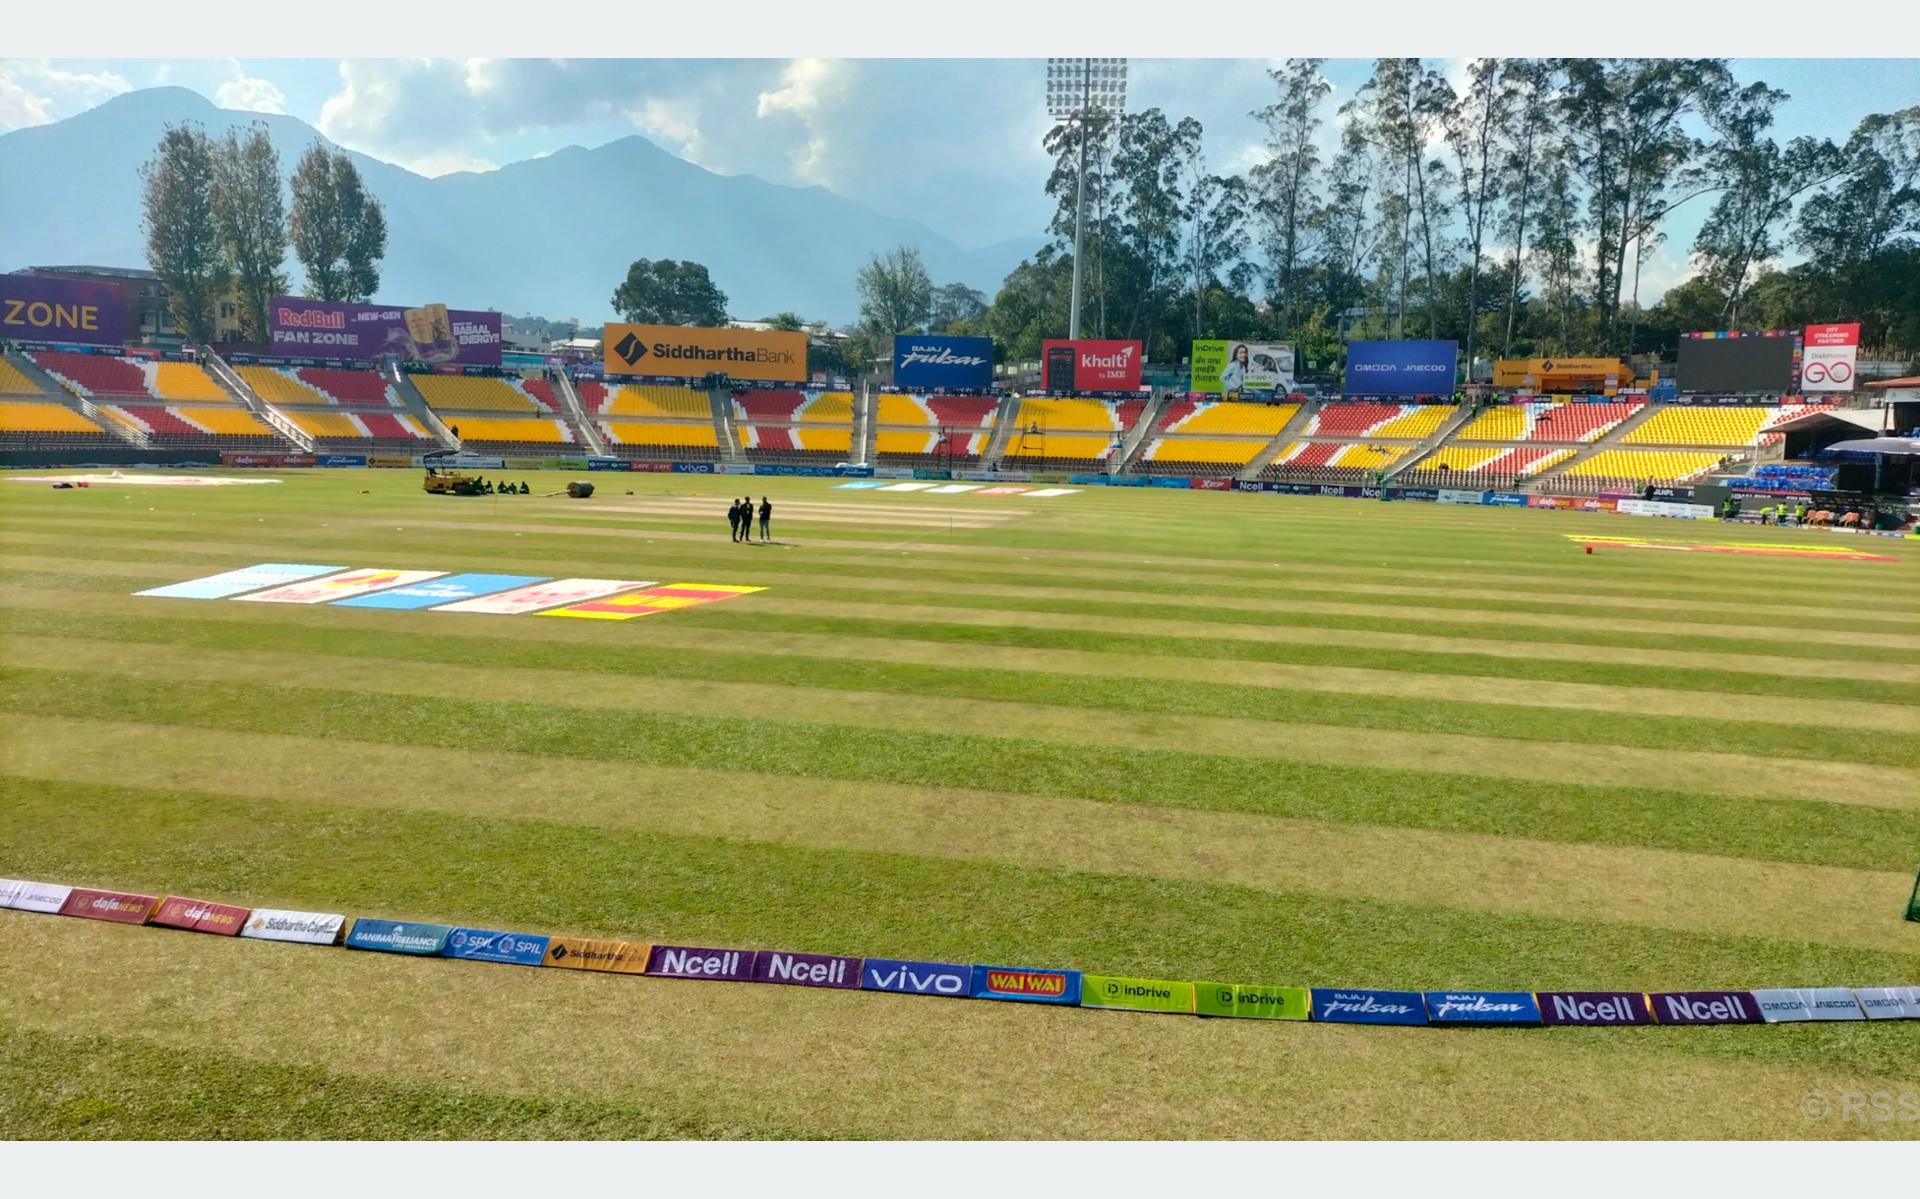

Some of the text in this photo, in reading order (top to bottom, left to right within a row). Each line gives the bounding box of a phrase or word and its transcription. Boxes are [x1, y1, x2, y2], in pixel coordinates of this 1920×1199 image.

[4, 299, 98, 330] ZONE
[278, 308, 345, 328] Red Bull
[274, 330, 358, 345] FAN ZONE
[1195, 344, 1224, 352] inDrive
[900, 348, 987, 368] pulsar
[1082, 354, 1127, 367] khalti
[1107, 370, 1126, 378] IME
[1354, 364, 1446, 372] OMODA JAECOO
[1805, 361, 1852, 383] GO
[679, 463, 708, 472] vivo
[1239, 481, 1264, 491] Ncell
[1320, 485, 1344, 495] Ncell
[355, 932, 394, 944] SANIMA
[468, 936, 541, 954] SPIL SPIL
[663, 949, 739, 975] Ncell
[769, 953, 846, 984] Ncell
[871, 964, 963, 993] vivo
[991, 974, 1062, 994] WAI WAI
[1124, 985, 1171, 1000] inDrive
[1237, 991, 1285, 1006] inDrive
[1323, 996, 1415, 1018] pulsar
[1435, 996, 1526, 1018] pulsar
[1552, 995, 1634, 1021] Ncell
[1665, 995, 1748, 1021] Ncell
[1762, 1000, 1856, 1010] OMODA JAECOO
